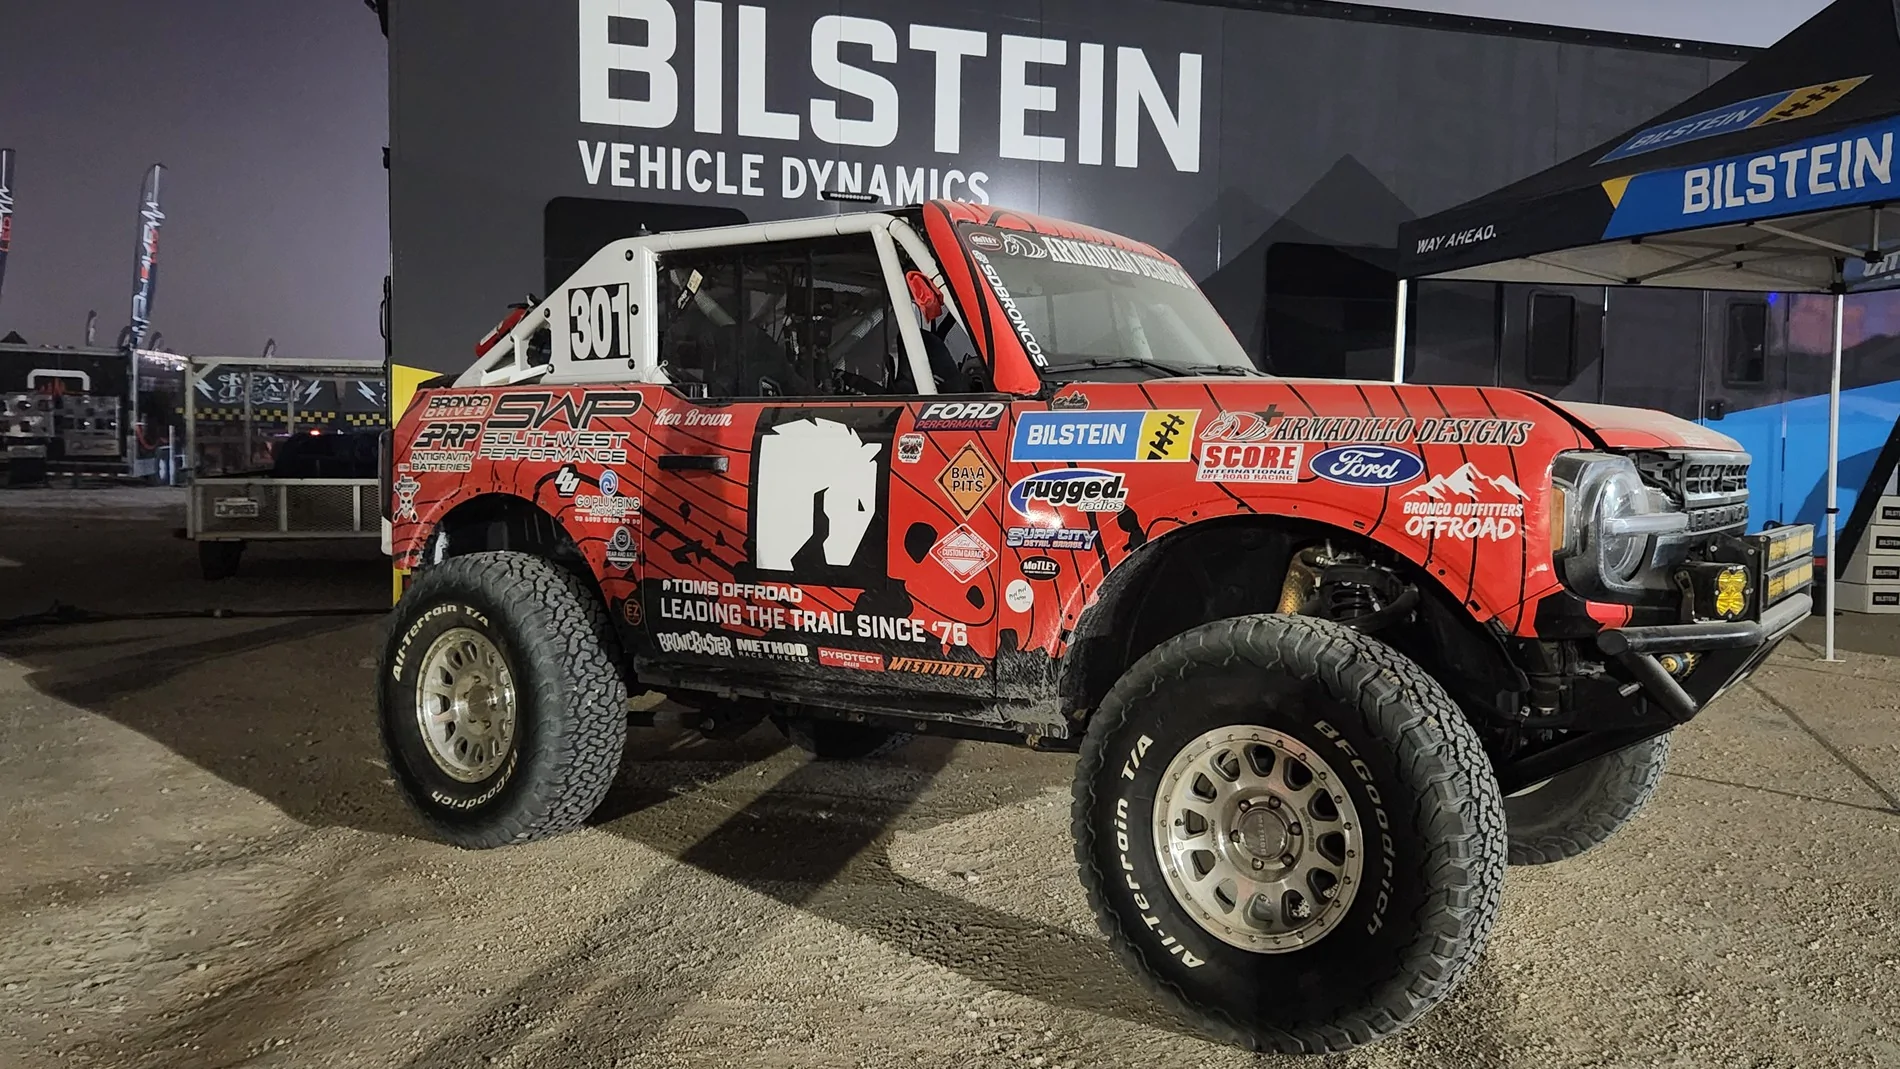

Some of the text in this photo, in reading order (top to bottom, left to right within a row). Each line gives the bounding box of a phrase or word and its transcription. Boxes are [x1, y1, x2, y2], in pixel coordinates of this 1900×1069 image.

[579, 0, 1202, 173] BILSTEIN
[1627, 107, 1760, 150] BILSTEIN
[578, 140, 989, 207] VEHICLE DYNAMICS
[1683, 132, 1893, 214] BILSTEIN
[1416, 223, 1497, 254] WAY AHEAD.
[1041, 236, 1142, 276] ARMADILLO
[972, 250, 1048, 368] @SDBRONCOS
[570, 285, 630, 360] 301
[424, 406, 486, 417] DRIVER
[429, 395, 492, 409] BRONCO
[485, 392, 642, 430] SWP
[922, 403, 1005, 420] FORD
[655, 408, 733, 427] Ken Brown
[915, 419, 995, 429] PERFORMANCE
[412, 423, 482, 448] PRP
[482, 431, 629, 448] SOUTHWEST
[1027, 423, 1127, 445] BILSTEIN
[1272, 416, 1535, 447] ARMADILLO DESIGNS
[411, 452, 475, 462] ANTIGRAVITY
[412, 463, 471, 471] BATTERIES
[479, 448, 627, 464] PERFORMANCE
[1203, 446, 1296, 469] SCORE
[1328, 449, 1402, 480] Ford
[952, 480, 983, 492] PITS
[1253, 474, 1294, 482] RACING
[594, 496, 640, 509] PLUMBING
[1079, 500, 1124, 511] radios
[1402, 502, 1523, 517] BRONCO OUTFITTERS
[1007, 527, 1056, 546] SURF
[1057, 529, 1099, 550] CITY
[1404, 517, 1516, 542] OFFROAD
[942, 548, 984, 559] CUSTOM GARAGE
[1023, 539, 1051, 548] DETAIL
[672, 578, 802, 602] TOMS OFFROAD
[626, 603, 640, 617] EZ
[661, 598, 742, 625] LEADING
[746, 605, 786, 630] THE
[790, 609, 852, 635] TRAIL
[857, 614, 925, 643] SINCE
[392, 603, 490, 682] All-Terrain T/A
[657, 630, 735, 659] BRONCBUSTER
[736, 638, 809, 657] METHOD
[738, 651, 810, 664] RACE WHEELS
[820, 650, 881, 665] PYROTECT
[888, 656, 986, 680] MISHIMOTO
[1121, 733, 1154, 781] T/A
[431, 747, 519, 810] BFGoodrich
[1313, 720, 1396, 936] BFGoodrich
[1116, 798, 1206, 968] All-Terrain
